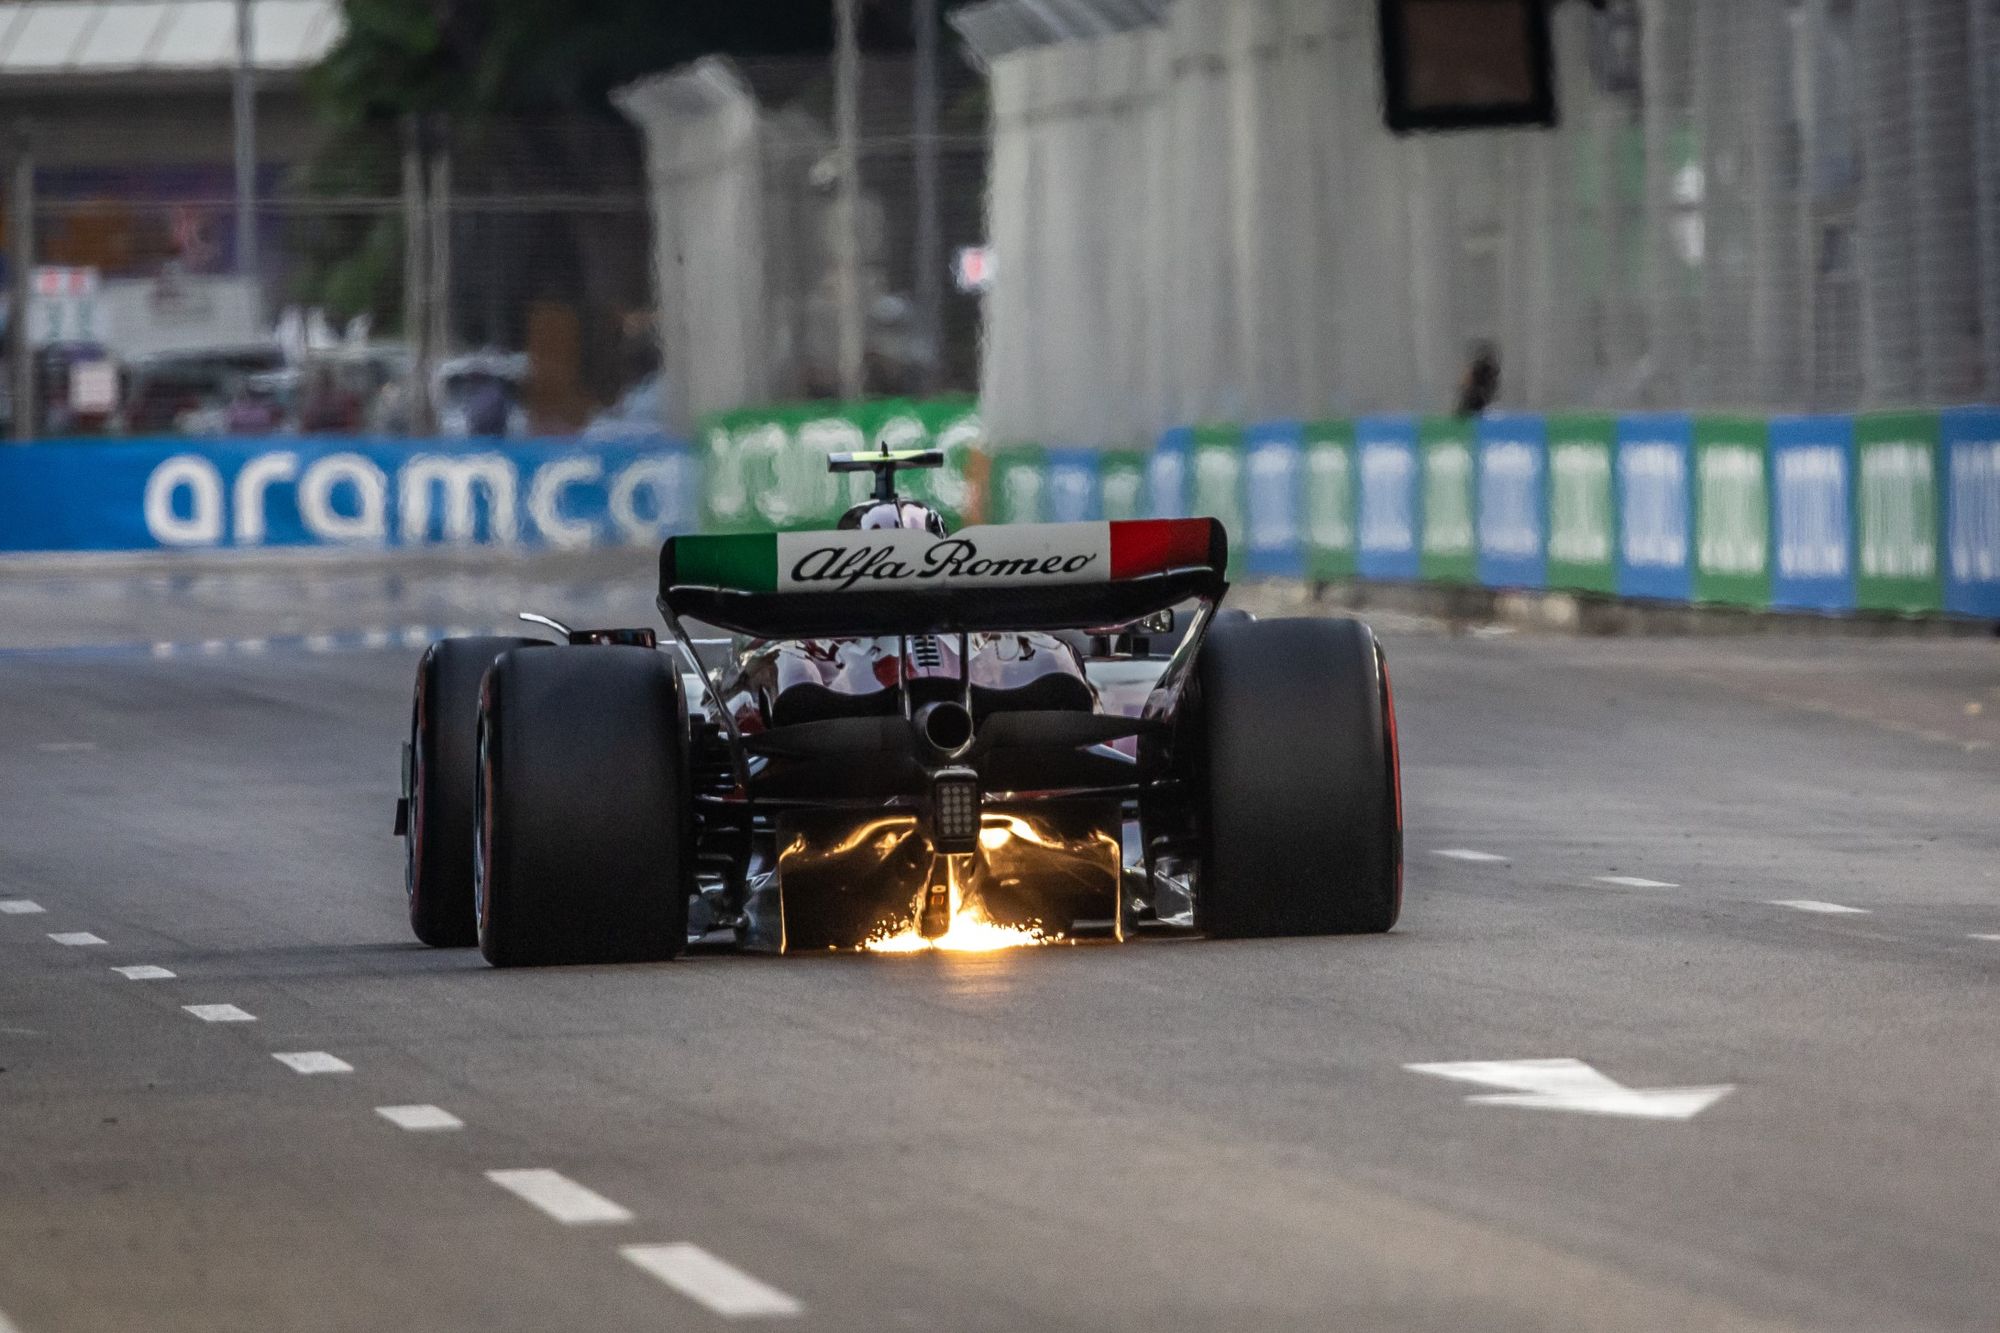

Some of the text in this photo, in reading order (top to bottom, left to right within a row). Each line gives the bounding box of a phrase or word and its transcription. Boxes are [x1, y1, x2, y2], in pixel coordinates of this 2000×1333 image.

[144, 450, 682, 548] aramco
[791, 539, 1097, 590] Alfa Romeo
